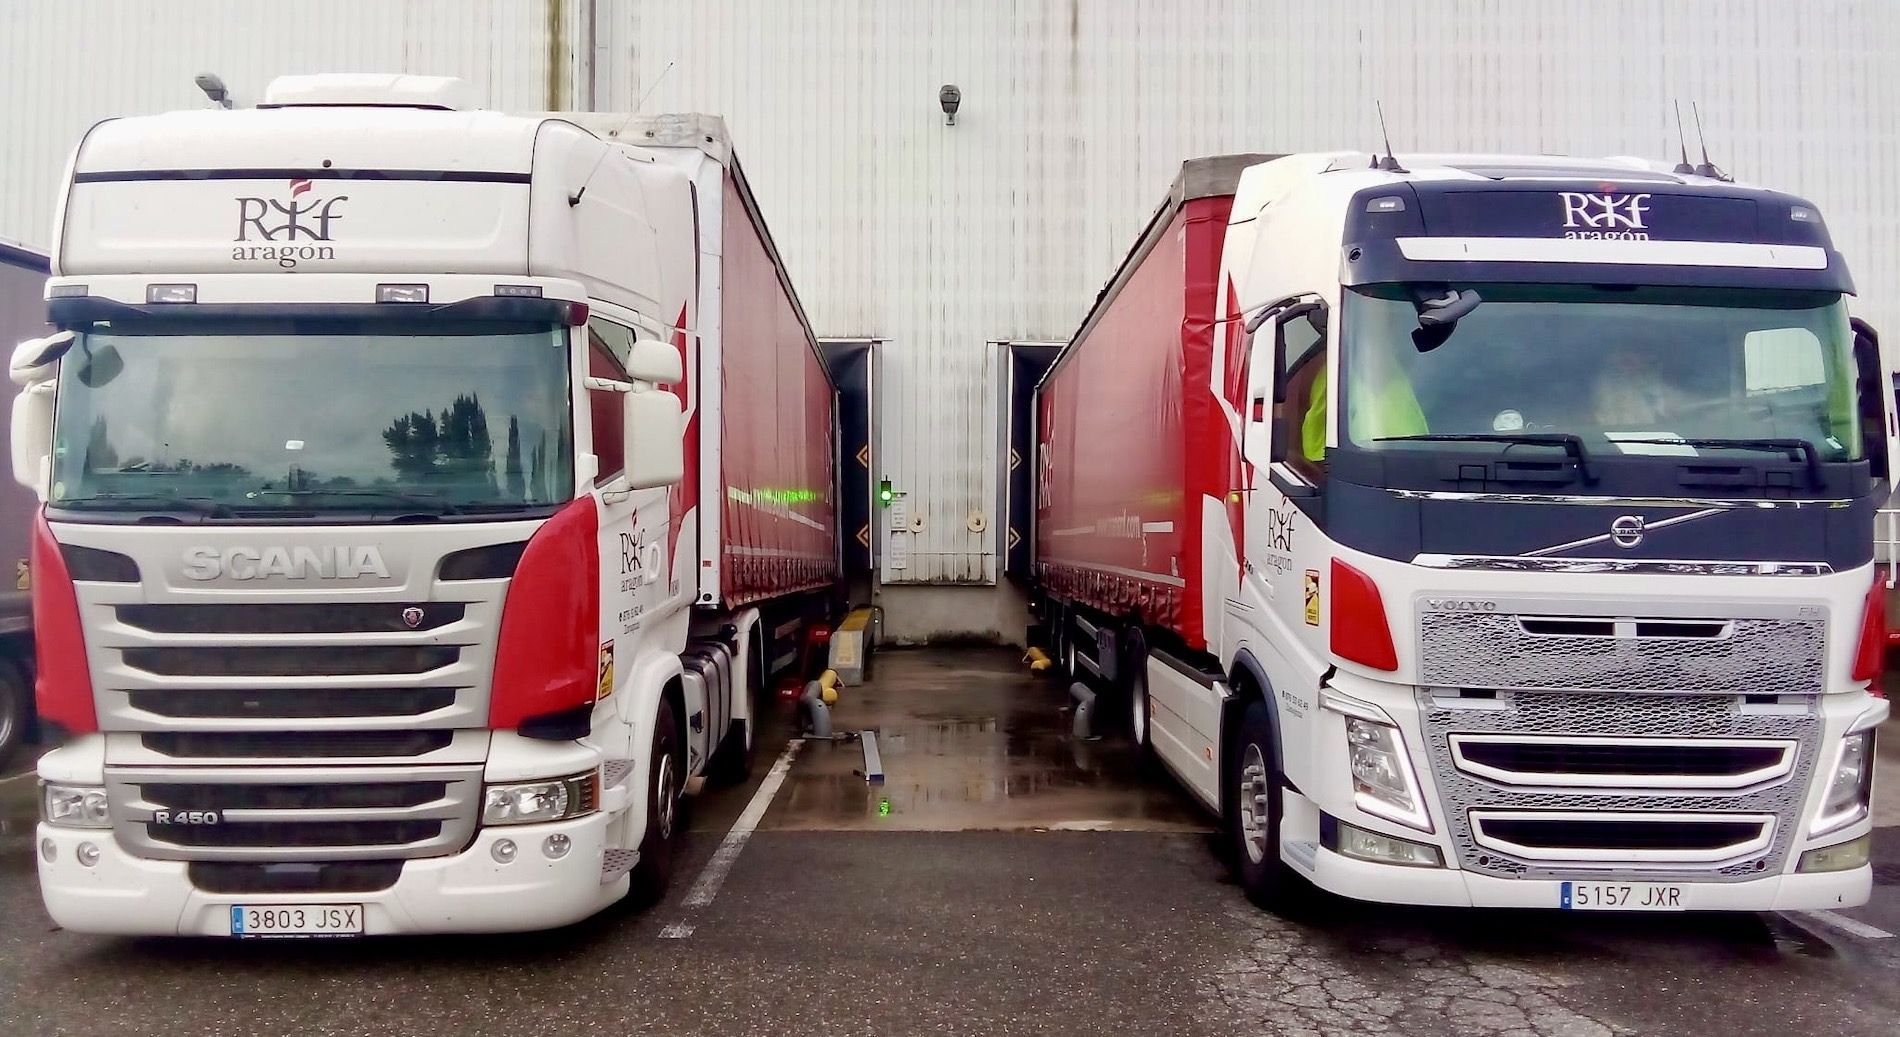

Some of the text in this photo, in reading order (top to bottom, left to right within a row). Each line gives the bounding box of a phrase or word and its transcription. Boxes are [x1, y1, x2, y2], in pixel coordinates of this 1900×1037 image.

[232, 242, 336, 268] aragón
[181, 545, 392, 581] SCANIA
[1427, 600, 1497, 612] VOLVO
[156, 811, 218, 825] R 450
[1577, 886, 1632, 906] 5157
[1641, 887, 1681, 907] JXR
[248, 910, 305, 929] 3803
[316, 909, 356, 929] JSX
